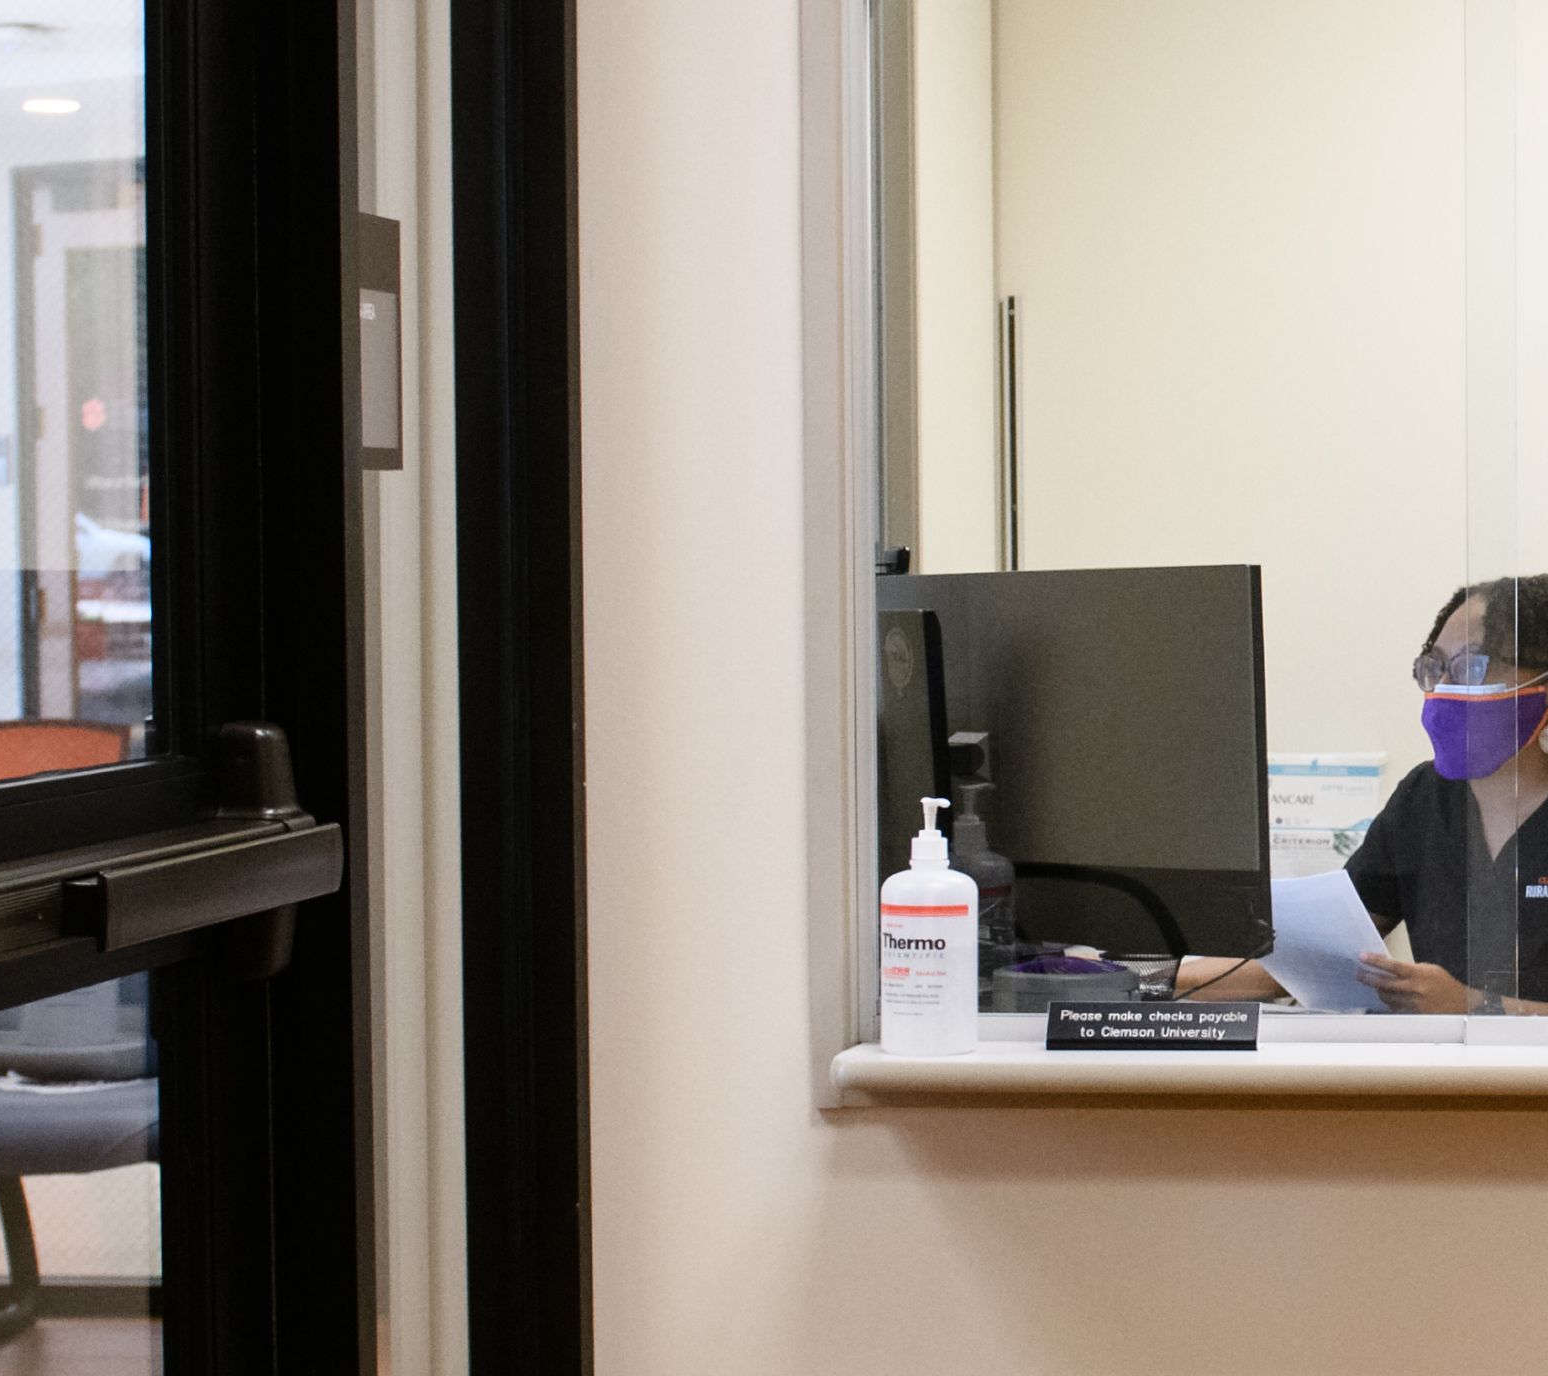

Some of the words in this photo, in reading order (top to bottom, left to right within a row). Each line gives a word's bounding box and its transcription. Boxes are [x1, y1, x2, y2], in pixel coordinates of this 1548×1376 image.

[883, 932, 946, 950] Thermo
[1060, 1009, 1102, 1021] Please
[1108, 1010, 1142, 1021] make
[1149, 1010, 1193, 1022] checks
[1199, 1011, 1248, 1023] payable
[1080, 1027, 1095, 1038] to
[1101, 1026, 1155, 1038] Clemson
[1161, 1026, 1226, 1040] University
